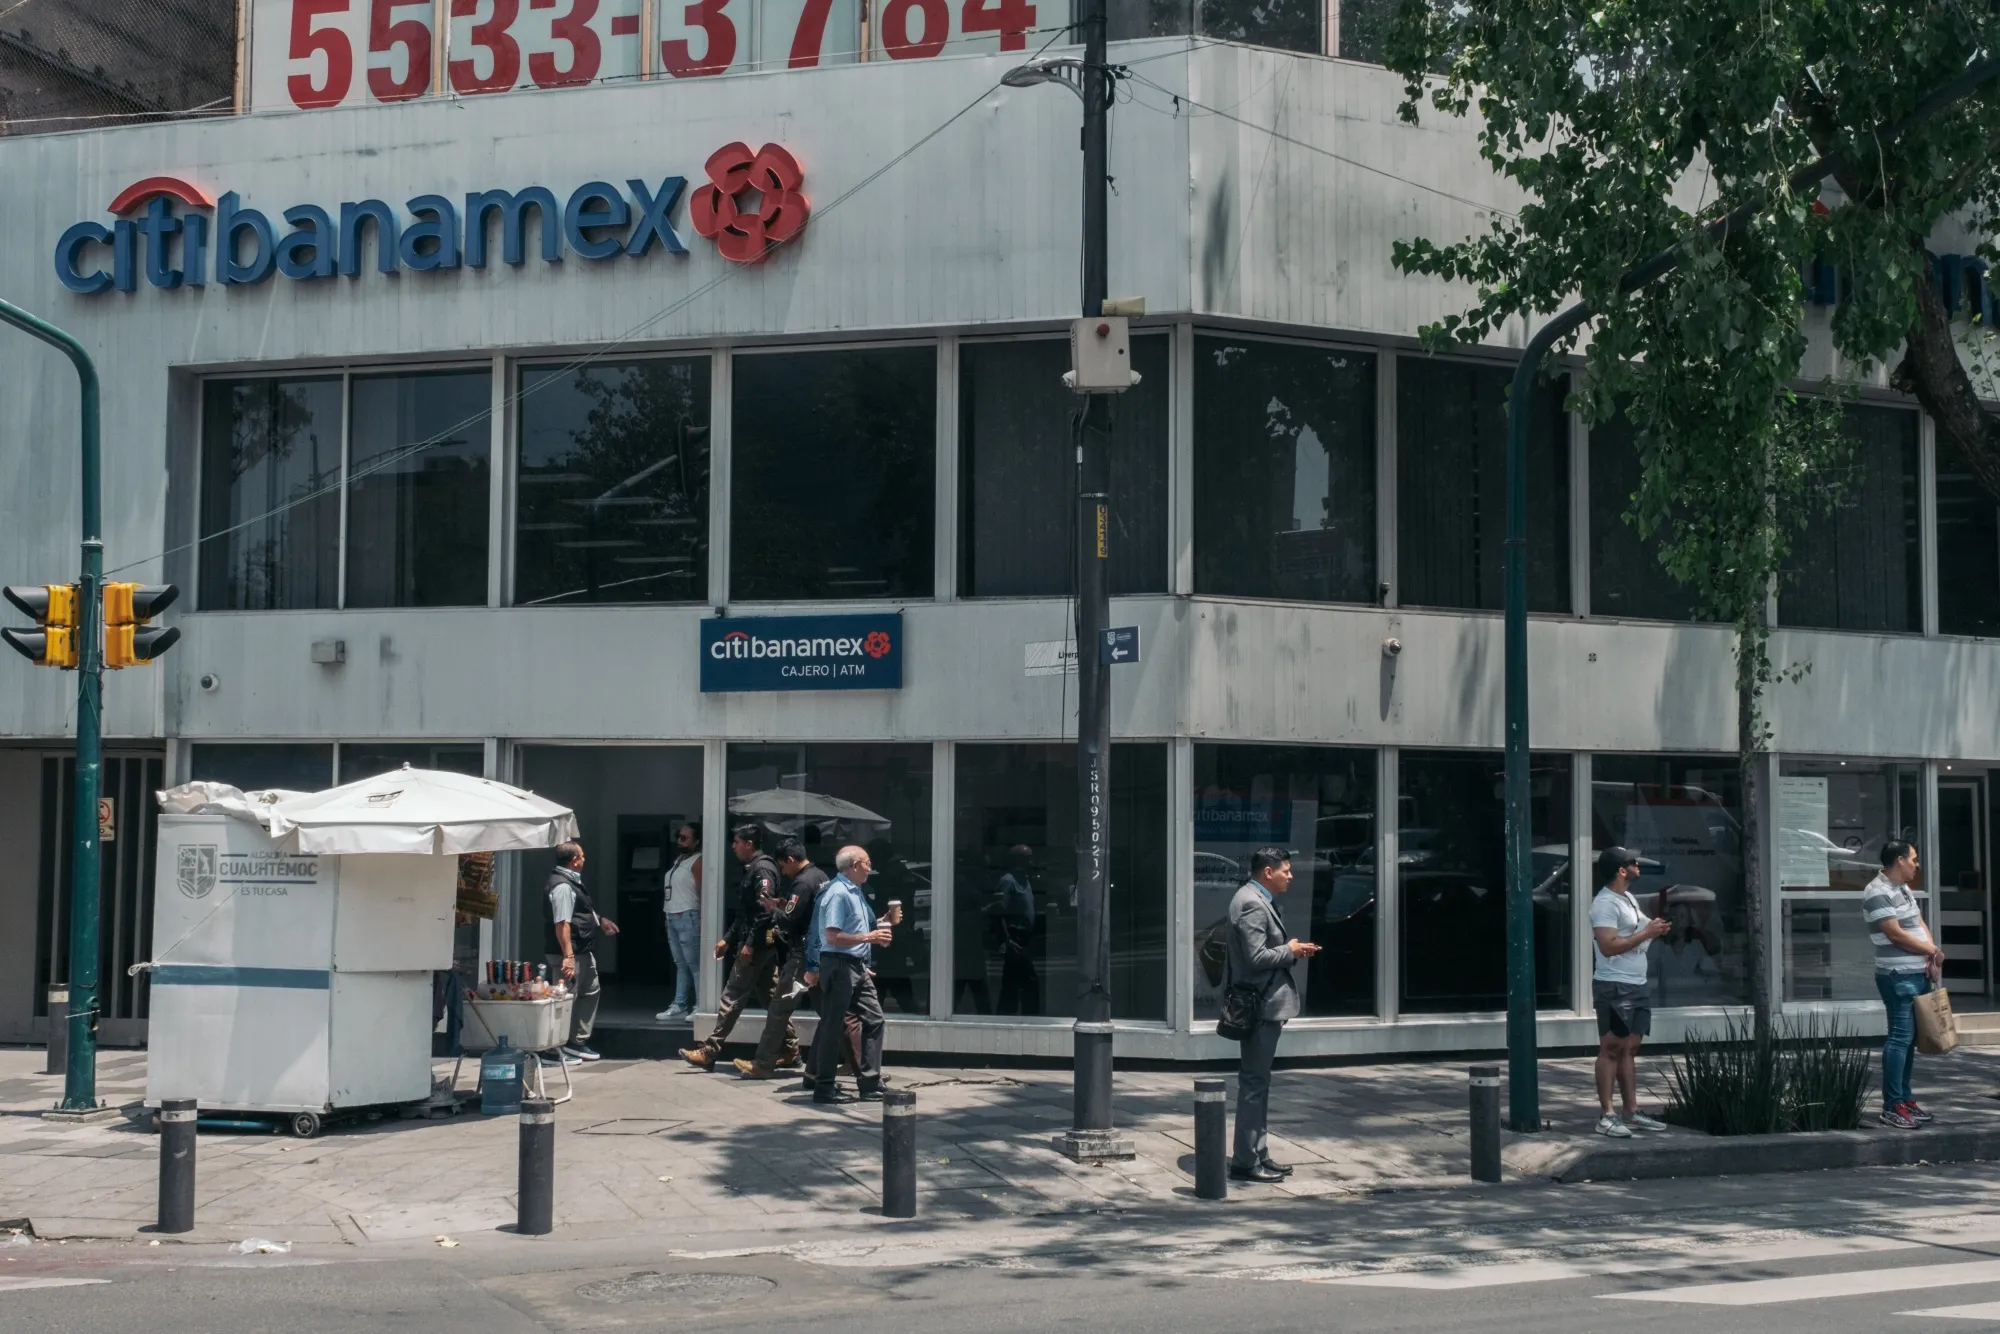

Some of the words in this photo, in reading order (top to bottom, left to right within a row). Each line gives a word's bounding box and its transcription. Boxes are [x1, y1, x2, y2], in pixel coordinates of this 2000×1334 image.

[54, 174, 691, 294] citibanamex
[710, 635, 864, 660] citibanamex
[1058, 651, 1078, 660] Liverp
[781, 665, 829, 677] CAJERO
[840, 664, 865, 676] ATM
[241, 887, 251, 896] ES
[253, 887, 264, 896] TU
[265, 887, 288, 896] CASA
